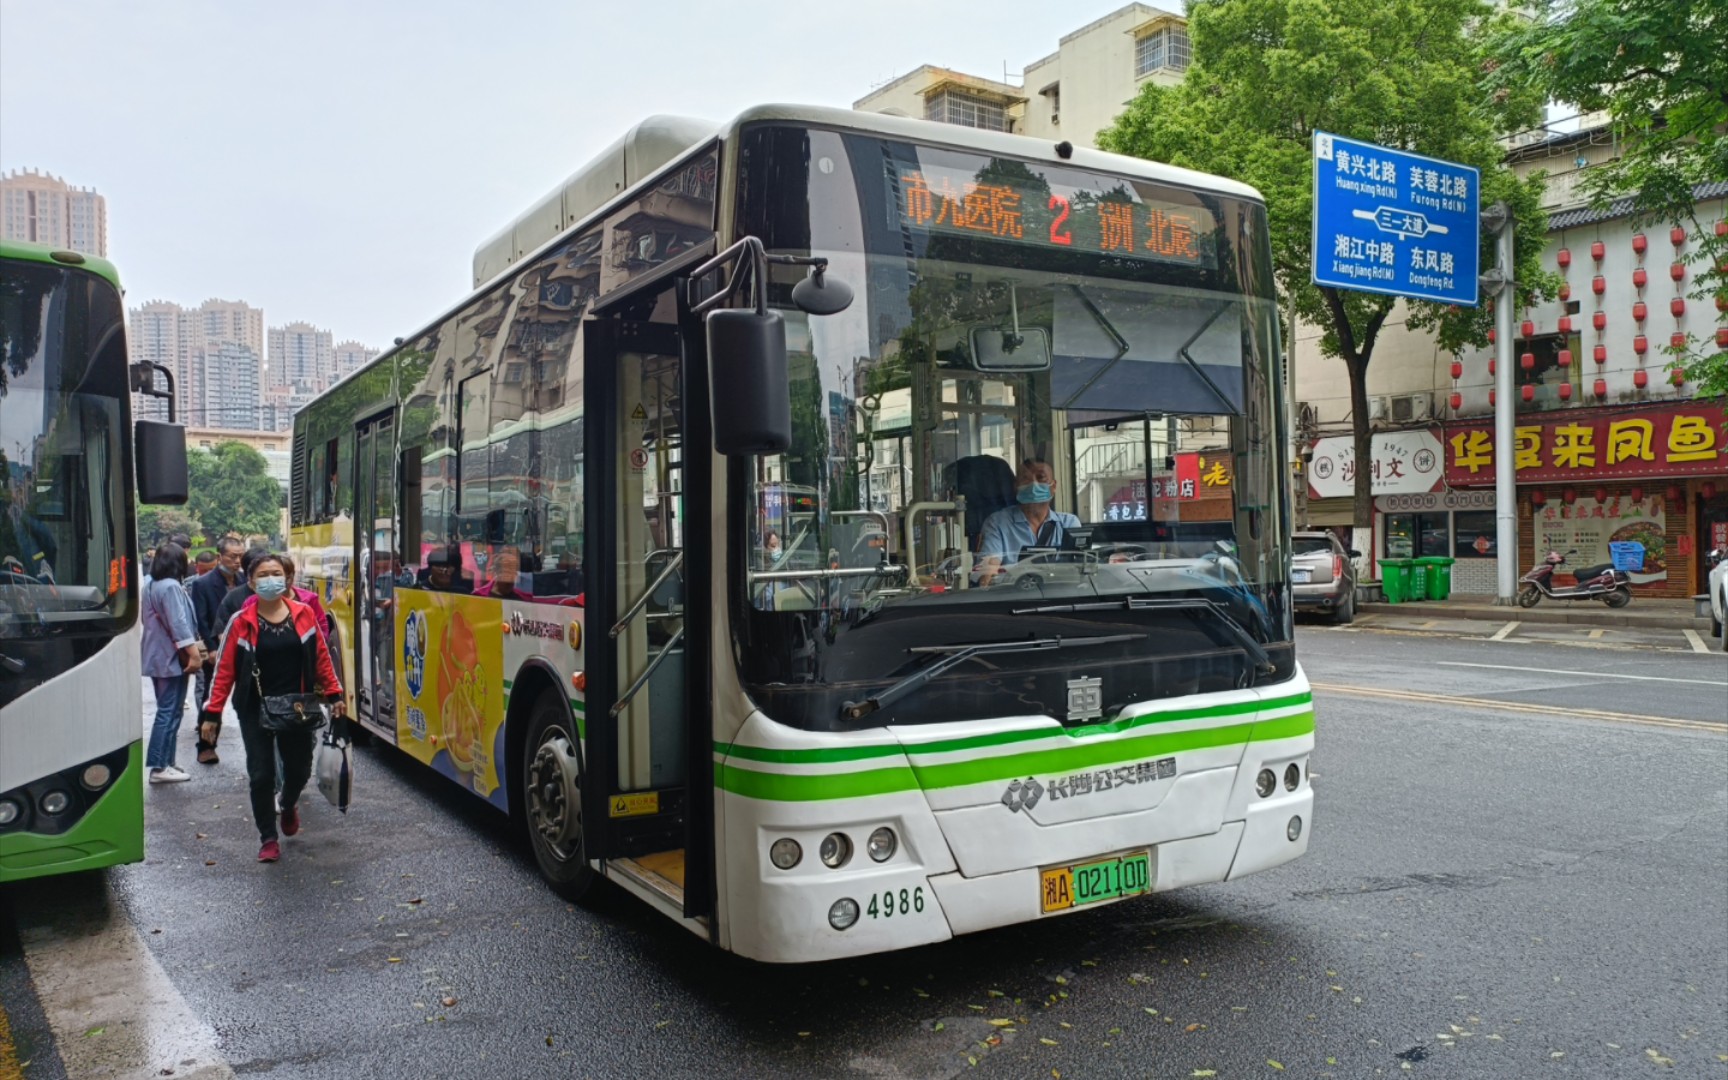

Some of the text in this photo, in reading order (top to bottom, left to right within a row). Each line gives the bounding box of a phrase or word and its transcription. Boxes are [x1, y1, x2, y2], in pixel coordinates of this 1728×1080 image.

[1336, 149, 1396, 184] 黄兴北路
[1410, 166, 1467, 199] 芙蓉北路
[901, 171, 1023, 238] 市九医院
[1048, 194, 1072, 245] 2
[1411, 191, 1466, 213] Furong Rd(N)
[1381, 211, 1423, 234] 三一大道
[1334, 234, 1395, 265] 湘江中路
[1411, 246, 1454, 274] 东风路
[1384, 442, 1408, 457] 1947
[1450, 415, 1717, 473] 华夏来凤鱼
[1078, 859, 1148, 899] 02110D
[867, 886, 924, 919] 4986
